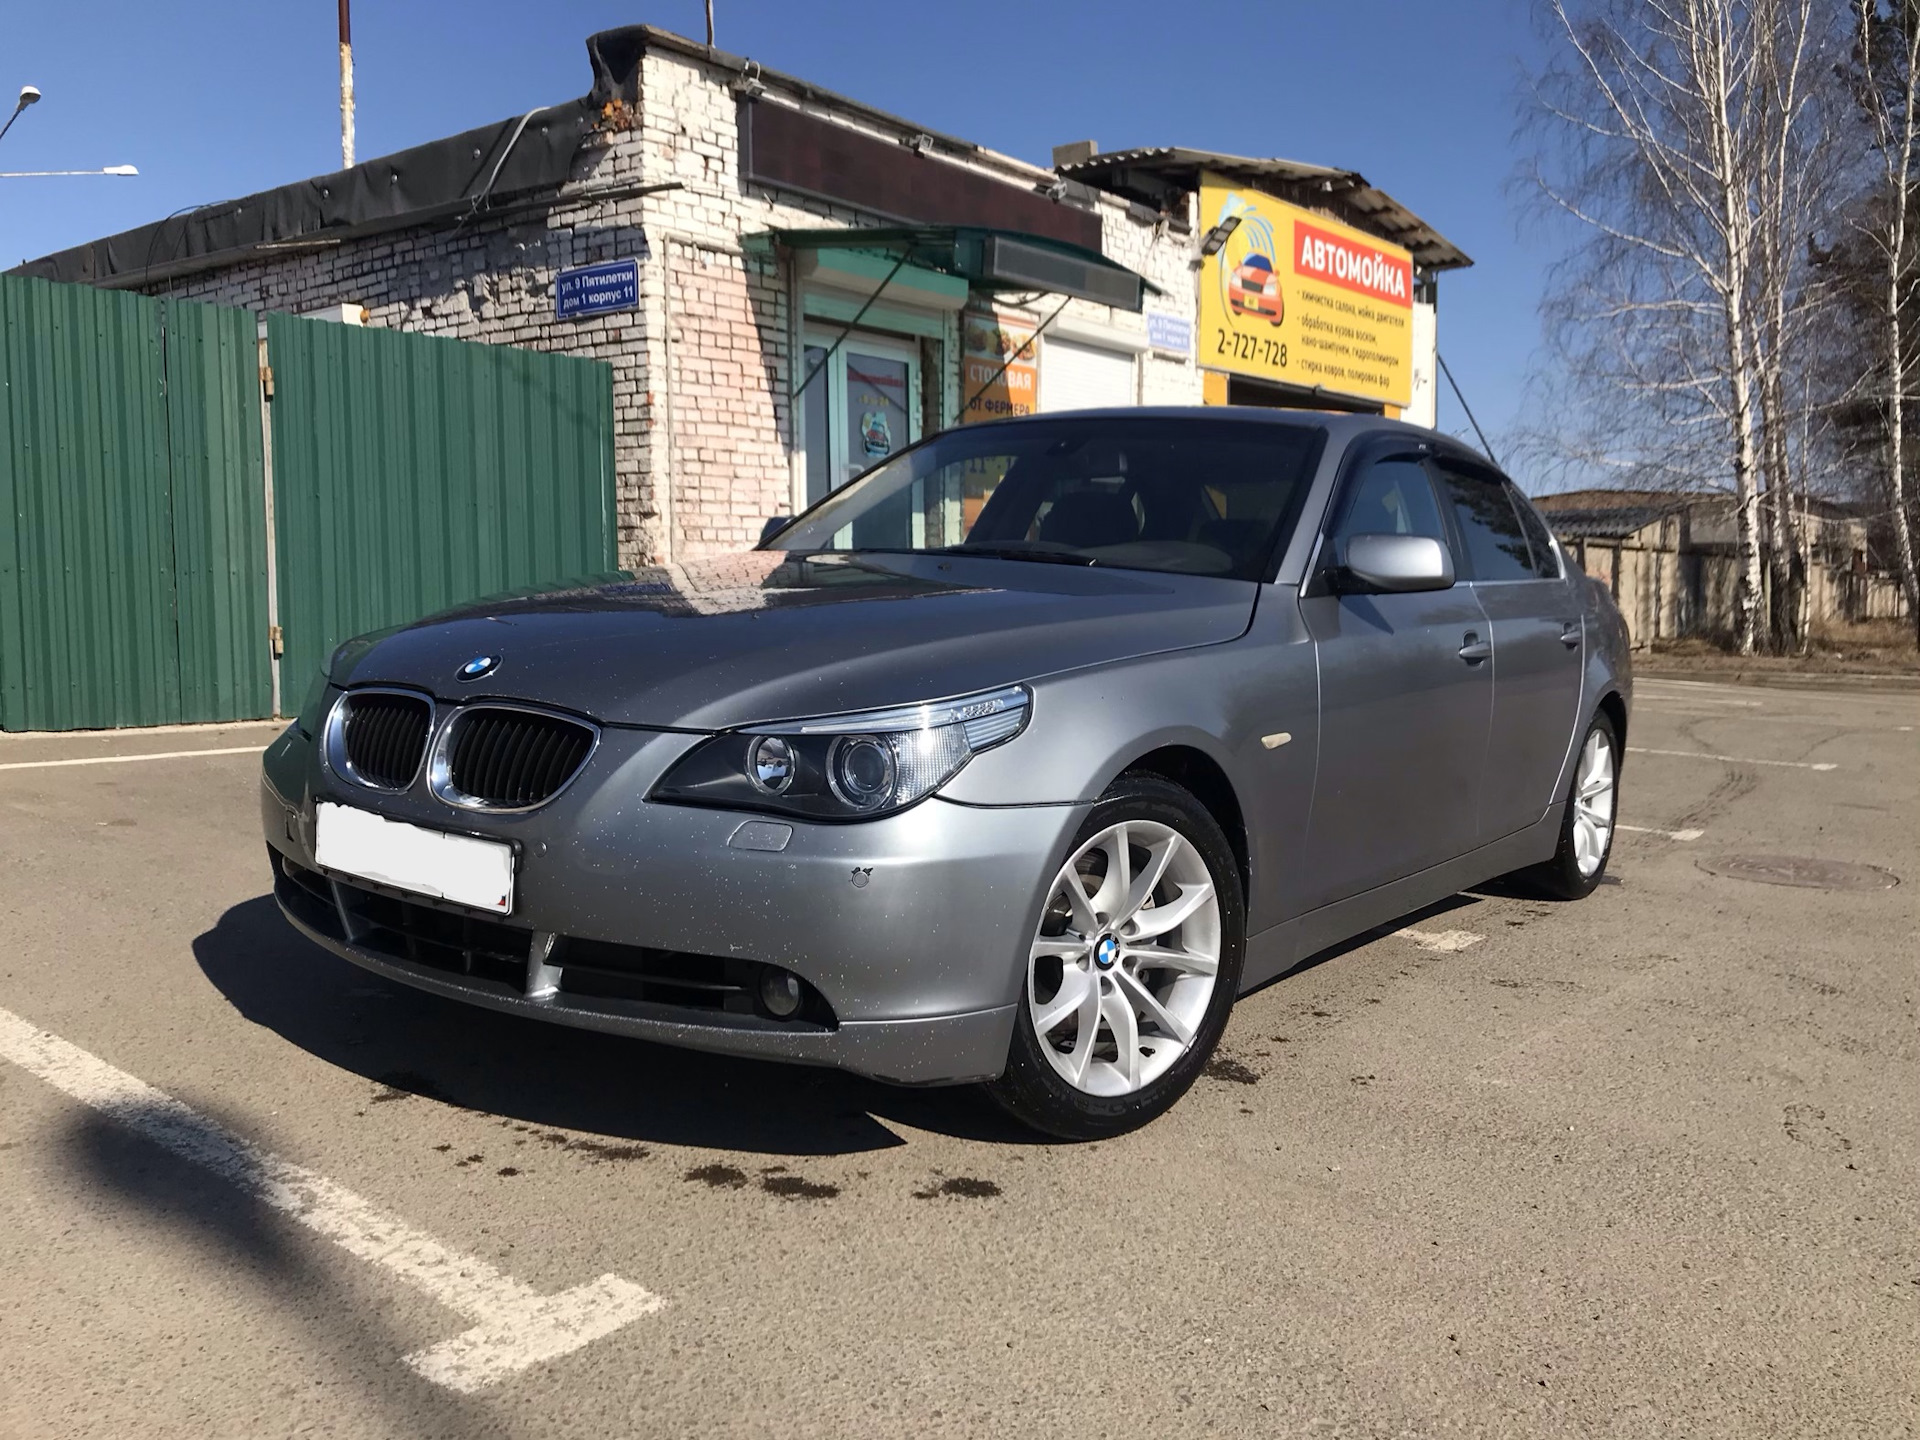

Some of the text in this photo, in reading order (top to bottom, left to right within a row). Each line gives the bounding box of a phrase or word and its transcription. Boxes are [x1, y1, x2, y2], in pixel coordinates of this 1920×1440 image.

[1301, 235, 1406, 299] АВТОМОЙКА
[561, 271, 633, 295] ул. 9 Пятилетки
[563, 285, 633, 310] дом 1 корпус 11
[1302, 312, 1333, 334] обработка
[1217, 328, 1287, 368] 2-727-728
[1301, 359, 1322, 374] стирка
[1379, 373, 1390, 390] фар
[970, 398, 1031, 417] ОТ ФЕРМЕРА
